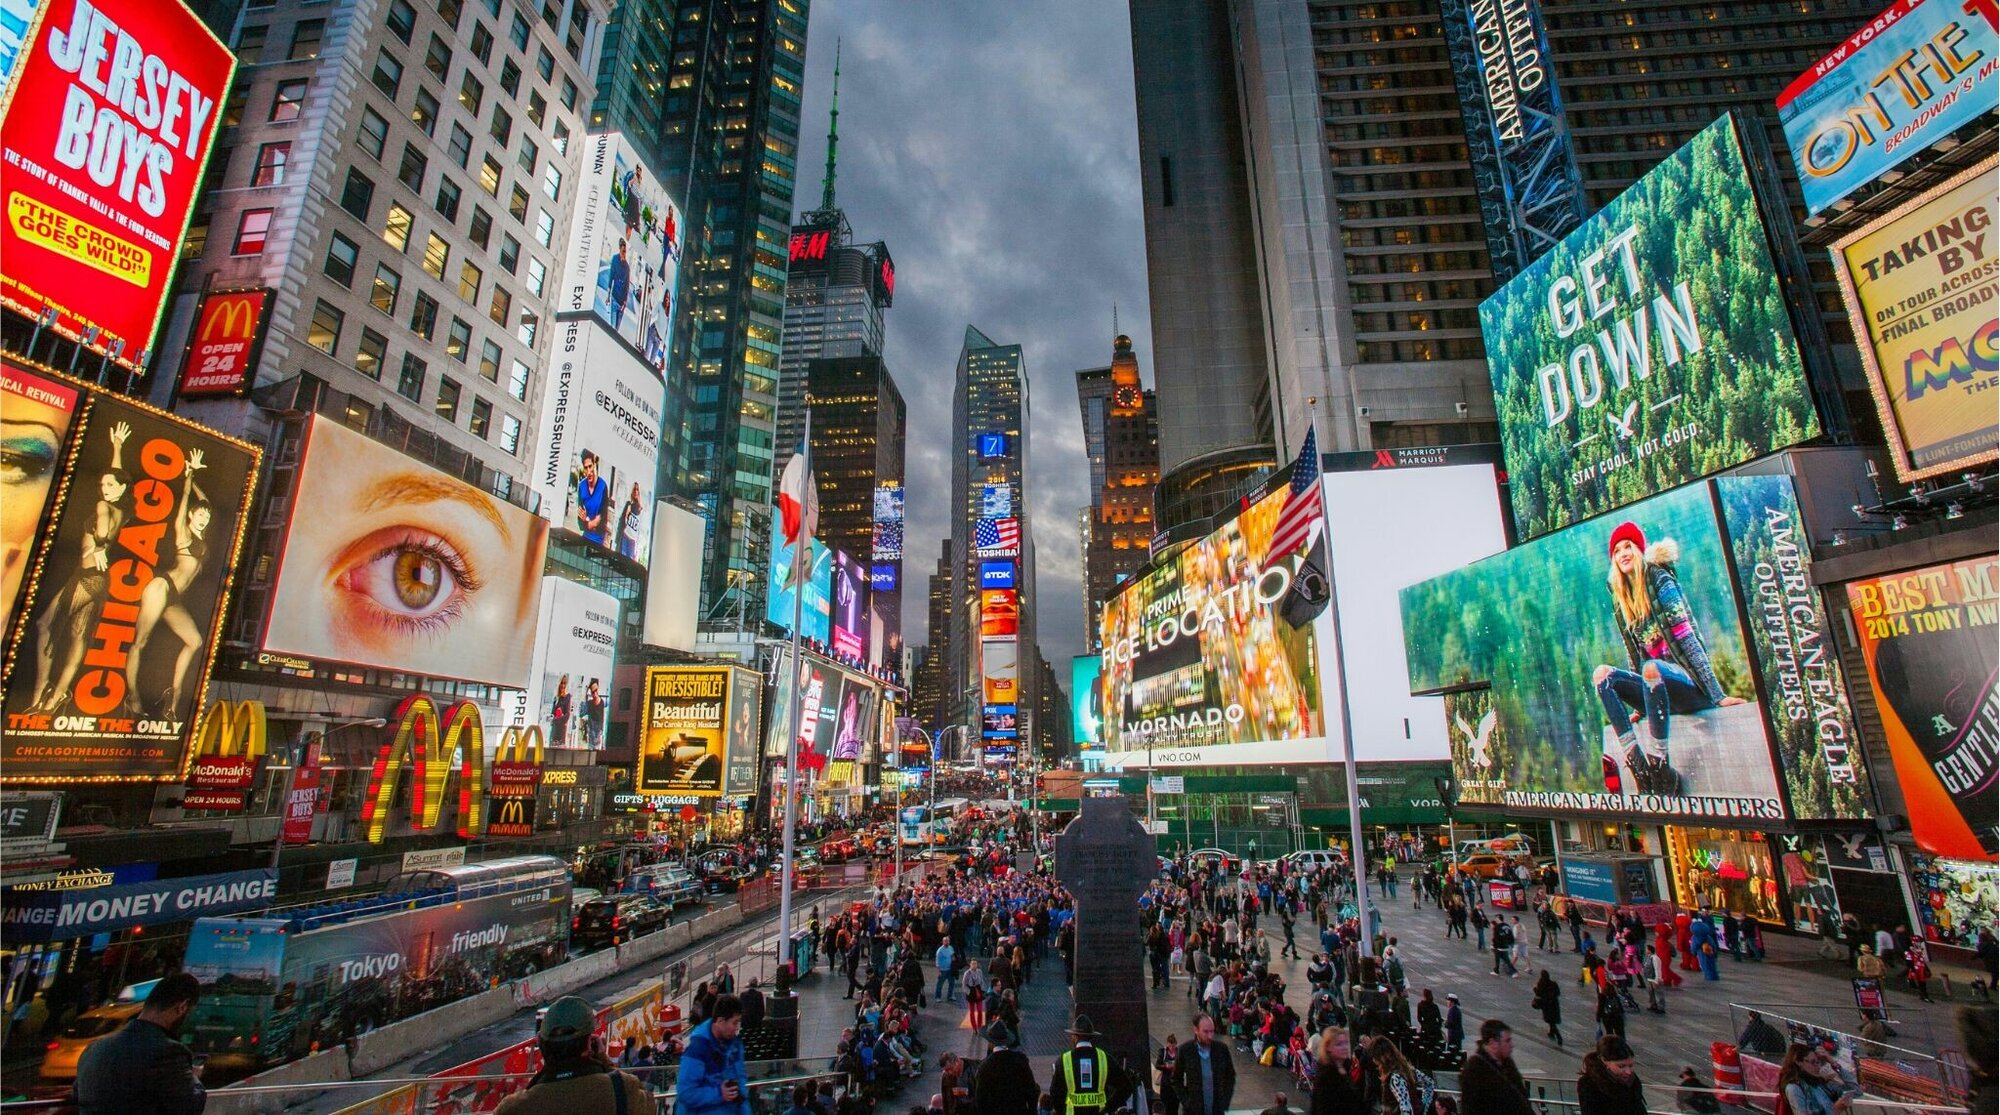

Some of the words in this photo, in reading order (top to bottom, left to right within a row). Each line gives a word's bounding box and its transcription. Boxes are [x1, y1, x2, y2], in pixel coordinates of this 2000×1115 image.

[1815, 46, 1846, 77] NEW
[1871, 22, 1984, 110] THE
[48, 0, 213, 160] JERSEY
[1885, 77, 1974, 155] BROADWAY'S
[54, 83, 174, 217] BOYS
[4, 148, 20, 166] THE
[21, 158, 47, 180] STORY
[48, 172, 58, 187] OF
[58, 178, 89, 204] FRANKIE
[89, 195, 108, 215] VALLI
[115, 212, 128, 227] THE
[145, 227, 171, 251] SEASONS
[18, 215, 80, 249] GOES
[74, 224, 144, 264] CROWD
[1861, 206, 1992, 282] TAKING
[1937, 233, 1985, 276] BY
[1548, 224, 1644, 339] GET
[1876, 306, 1896, 323] ON
[1897, 288, 1938, 313] TOUR
[1881, 315, 1930, 344] FINAL
[200, 355, 236, 373] 24
[201, 343, 244, 355] OPEN
[1537, 280, 1702, 429] DOWN
[187, 373, 241, 387] HOURS
[26, 386, 66, 409] REVIVAL
[545, 362, 573, 488] @EXPRESSRUNWAY
[1399, 448, 1448, 457] MARRIOTT
[1400, 456, 1443, 465] MARQUIS
[1572, 466, 1596, 486] STAY
[1600, 452, 1633, 475] COOL.
[1637, 439, 1662, 458] NOT
[977, 549, 1017, 557] TOSHIBA
[74, 438, 186, 715] CHICAGO
[1147, 585, 1191, 620] PRIME
[1856, 571, 1948, 618] BEST
[1865, 615, 1911, 640] 2014
[1911, 607, 1962, 634] TONY
[1754, 562, 1809, 721] OUTFITTERS
[1764, 506, 1828, 669] AMERICAN
[1806, 679, 1857, 785] EAGLE
[8, 714, 51, 731] THE
[53, 715, 98, 731] ONE
[99, 718, 136, 733] THE
[136, 719, 184, 735] ONLY
[653, 702, 721, 720] Beautiful
[1128, 703, 1245, 737] VORNADO
[1931, 714, 1958, 737] A
[1184, 729, 1225, 739] TRUST
[189, 762, 253, 779] McDonald's
[494, 767, 540, 776] McDonald's
[1157, 752, 1201, 763] VNO.COM
[196, 776, 241, 785] Restaurant
[184, 796, 205, 804] OPEN
[205, 796, 215, 804] 24
[216, 796, 242, 805] HOURS
[614, 795, 644, 804] GIFTS
[650, 795, 700, 805] LUGGAGE
[1506, 791, 1592, 810] AMERICAN
[1589, 792, 1643, 812] EAGLE
[1646, 795, 1783, 820] OUTFITTERS
[57, 892, 169, 927] MONEY
[177, 878, 279, 909] CHANGE
[511, 893, 541, 906] UNITED
[451, 923, 509, 955] friendly
[341, 952, 400, 985] Tokyo
